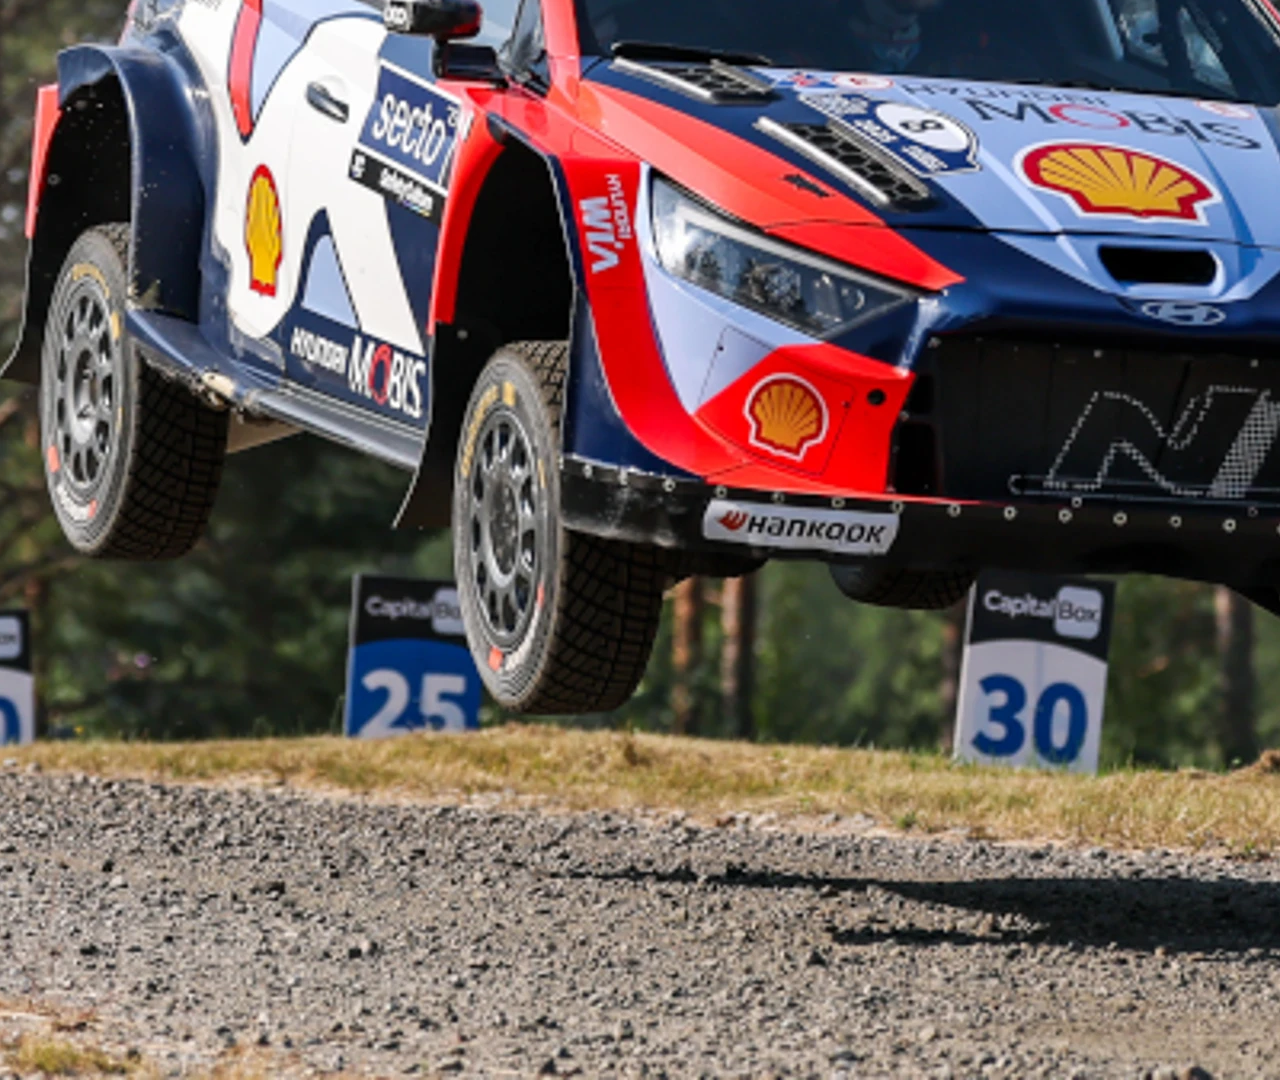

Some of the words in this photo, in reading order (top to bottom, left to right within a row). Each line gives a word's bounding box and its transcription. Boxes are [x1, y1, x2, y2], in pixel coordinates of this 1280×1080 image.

[372, 92, 447, 166] secto
[961, 96, 1262, 150] MOBIS
[348, 333, 426, 418] MOBIS
[358, 668, 467, 738] 25
[972, 672, 1089, 765] 30
